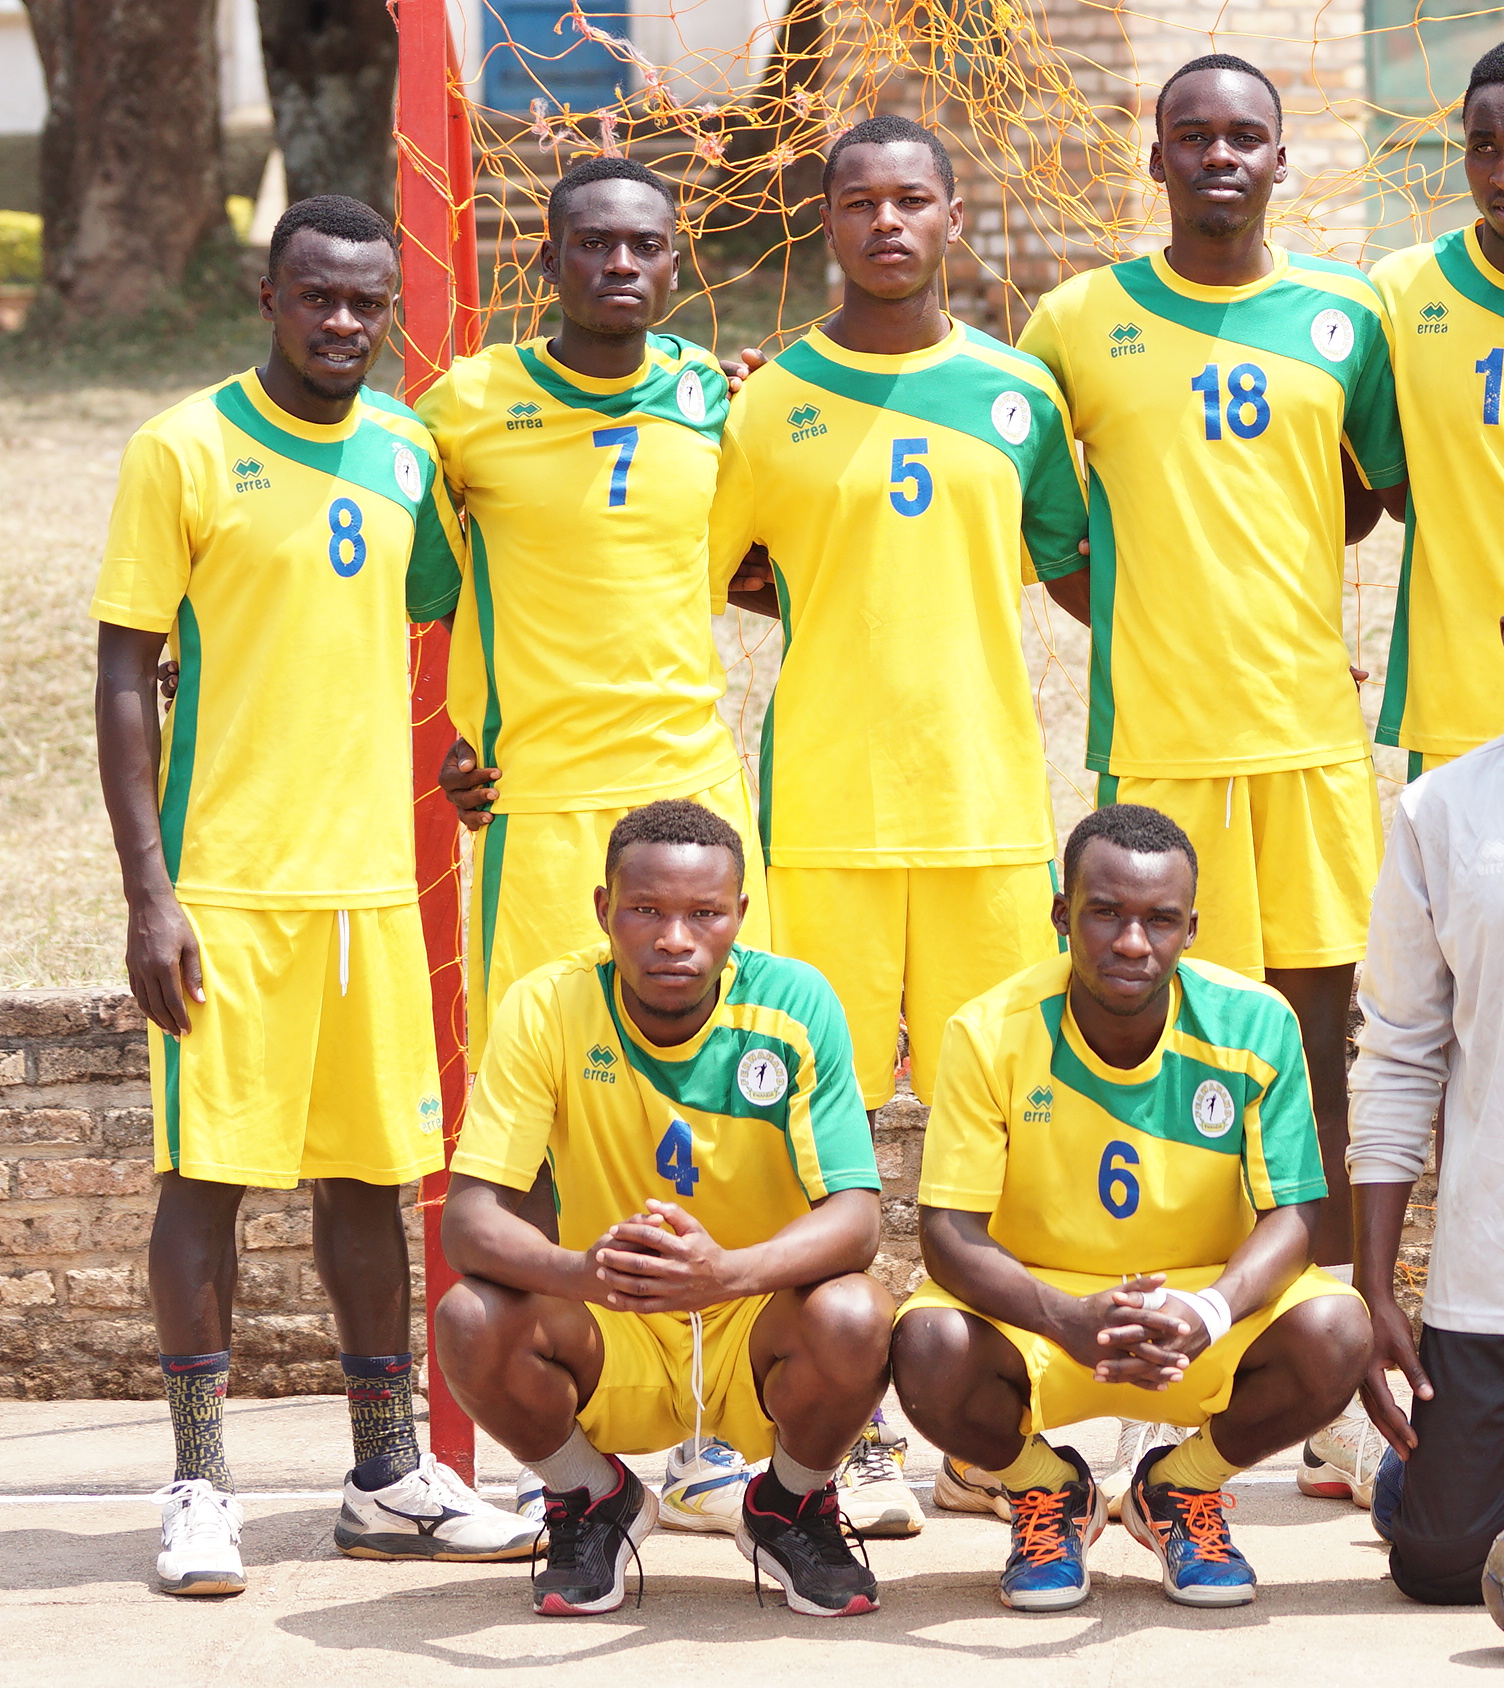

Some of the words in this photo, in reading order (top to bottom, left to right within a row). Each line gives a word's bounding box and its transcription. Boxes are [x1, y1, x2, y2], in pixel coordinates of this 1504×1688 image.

[1417, 323, 1448, 334] errea
[1110, 343, 1146, 358] errea
[1191, 363, 1271, 440] 18
[506, 417, 543, 430] errea
[792, 423, 828, 443] errea
[593, 426, 638, 507] 7
[236, 478, 271, 493] errea
[890, 437, 933, 517] 5
[329, 498, 366, 577] 8
[583, 1068, 616, 1084] errea
[422, 1117, 442, 1133] erre
[1023, 1110, 1051, 1123] erre
[656, 1120, 699, 1196] 4
[1099, 1140, 1139, 1219] 6
